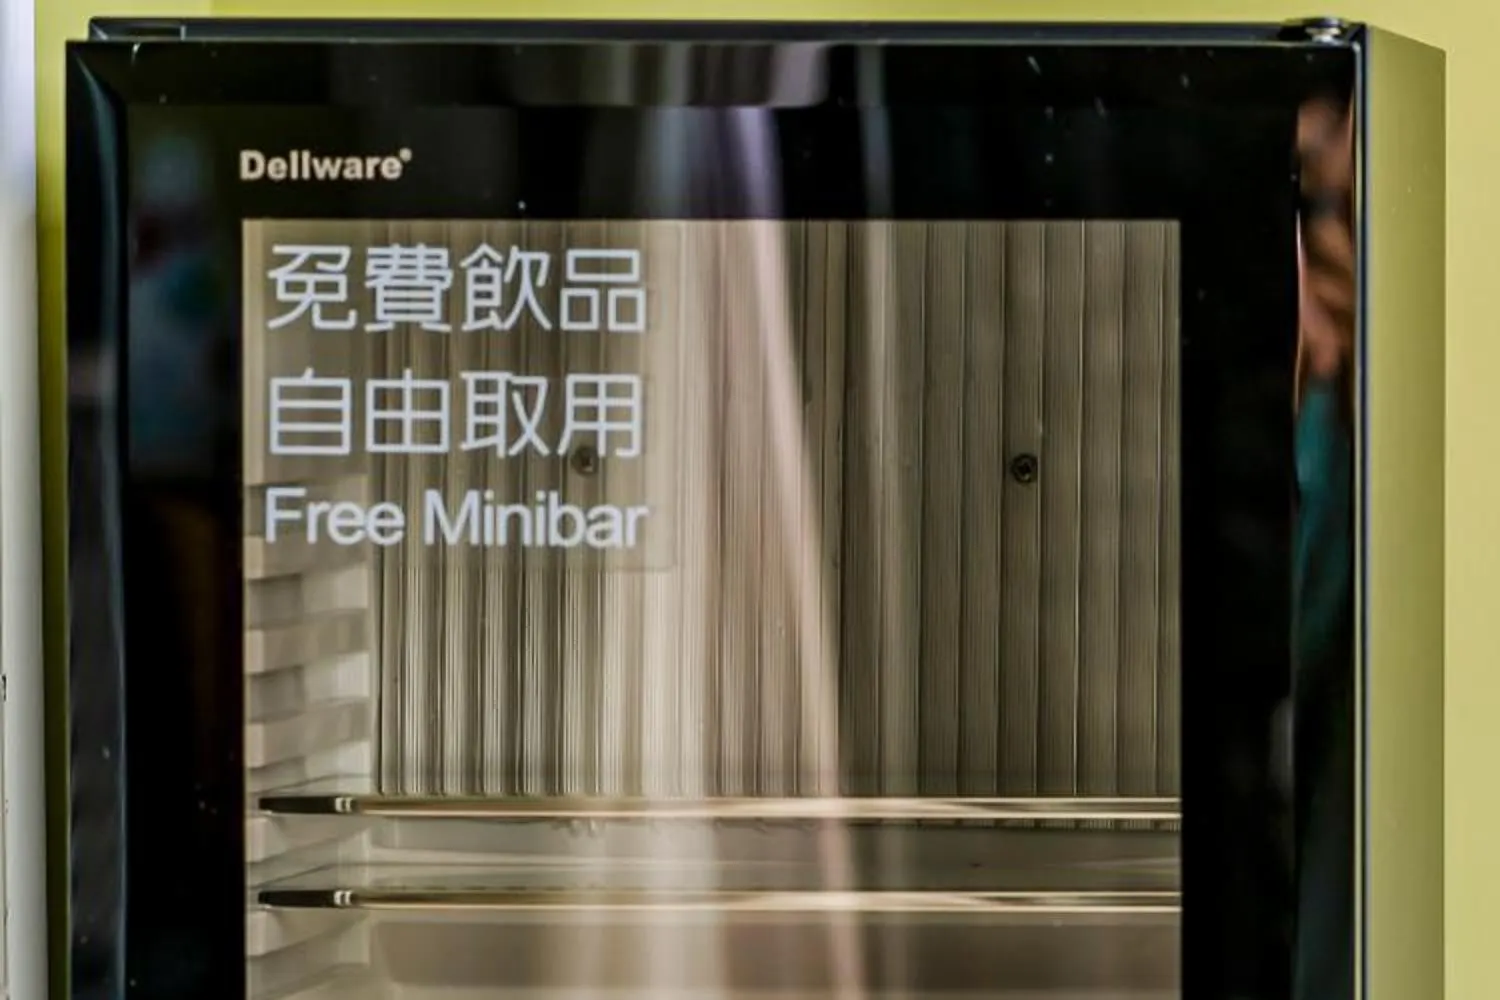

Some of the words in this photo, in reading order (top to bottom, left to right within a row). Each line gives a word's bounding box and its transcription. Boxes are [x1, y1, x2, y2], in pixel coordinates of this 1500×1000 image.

[266, 242, 647, 334] 免費飲品
[267, 367, 645, 460] 自由取用
[264, 486, 406, 546] Free
[424, 487, 649, 547] Minibar
